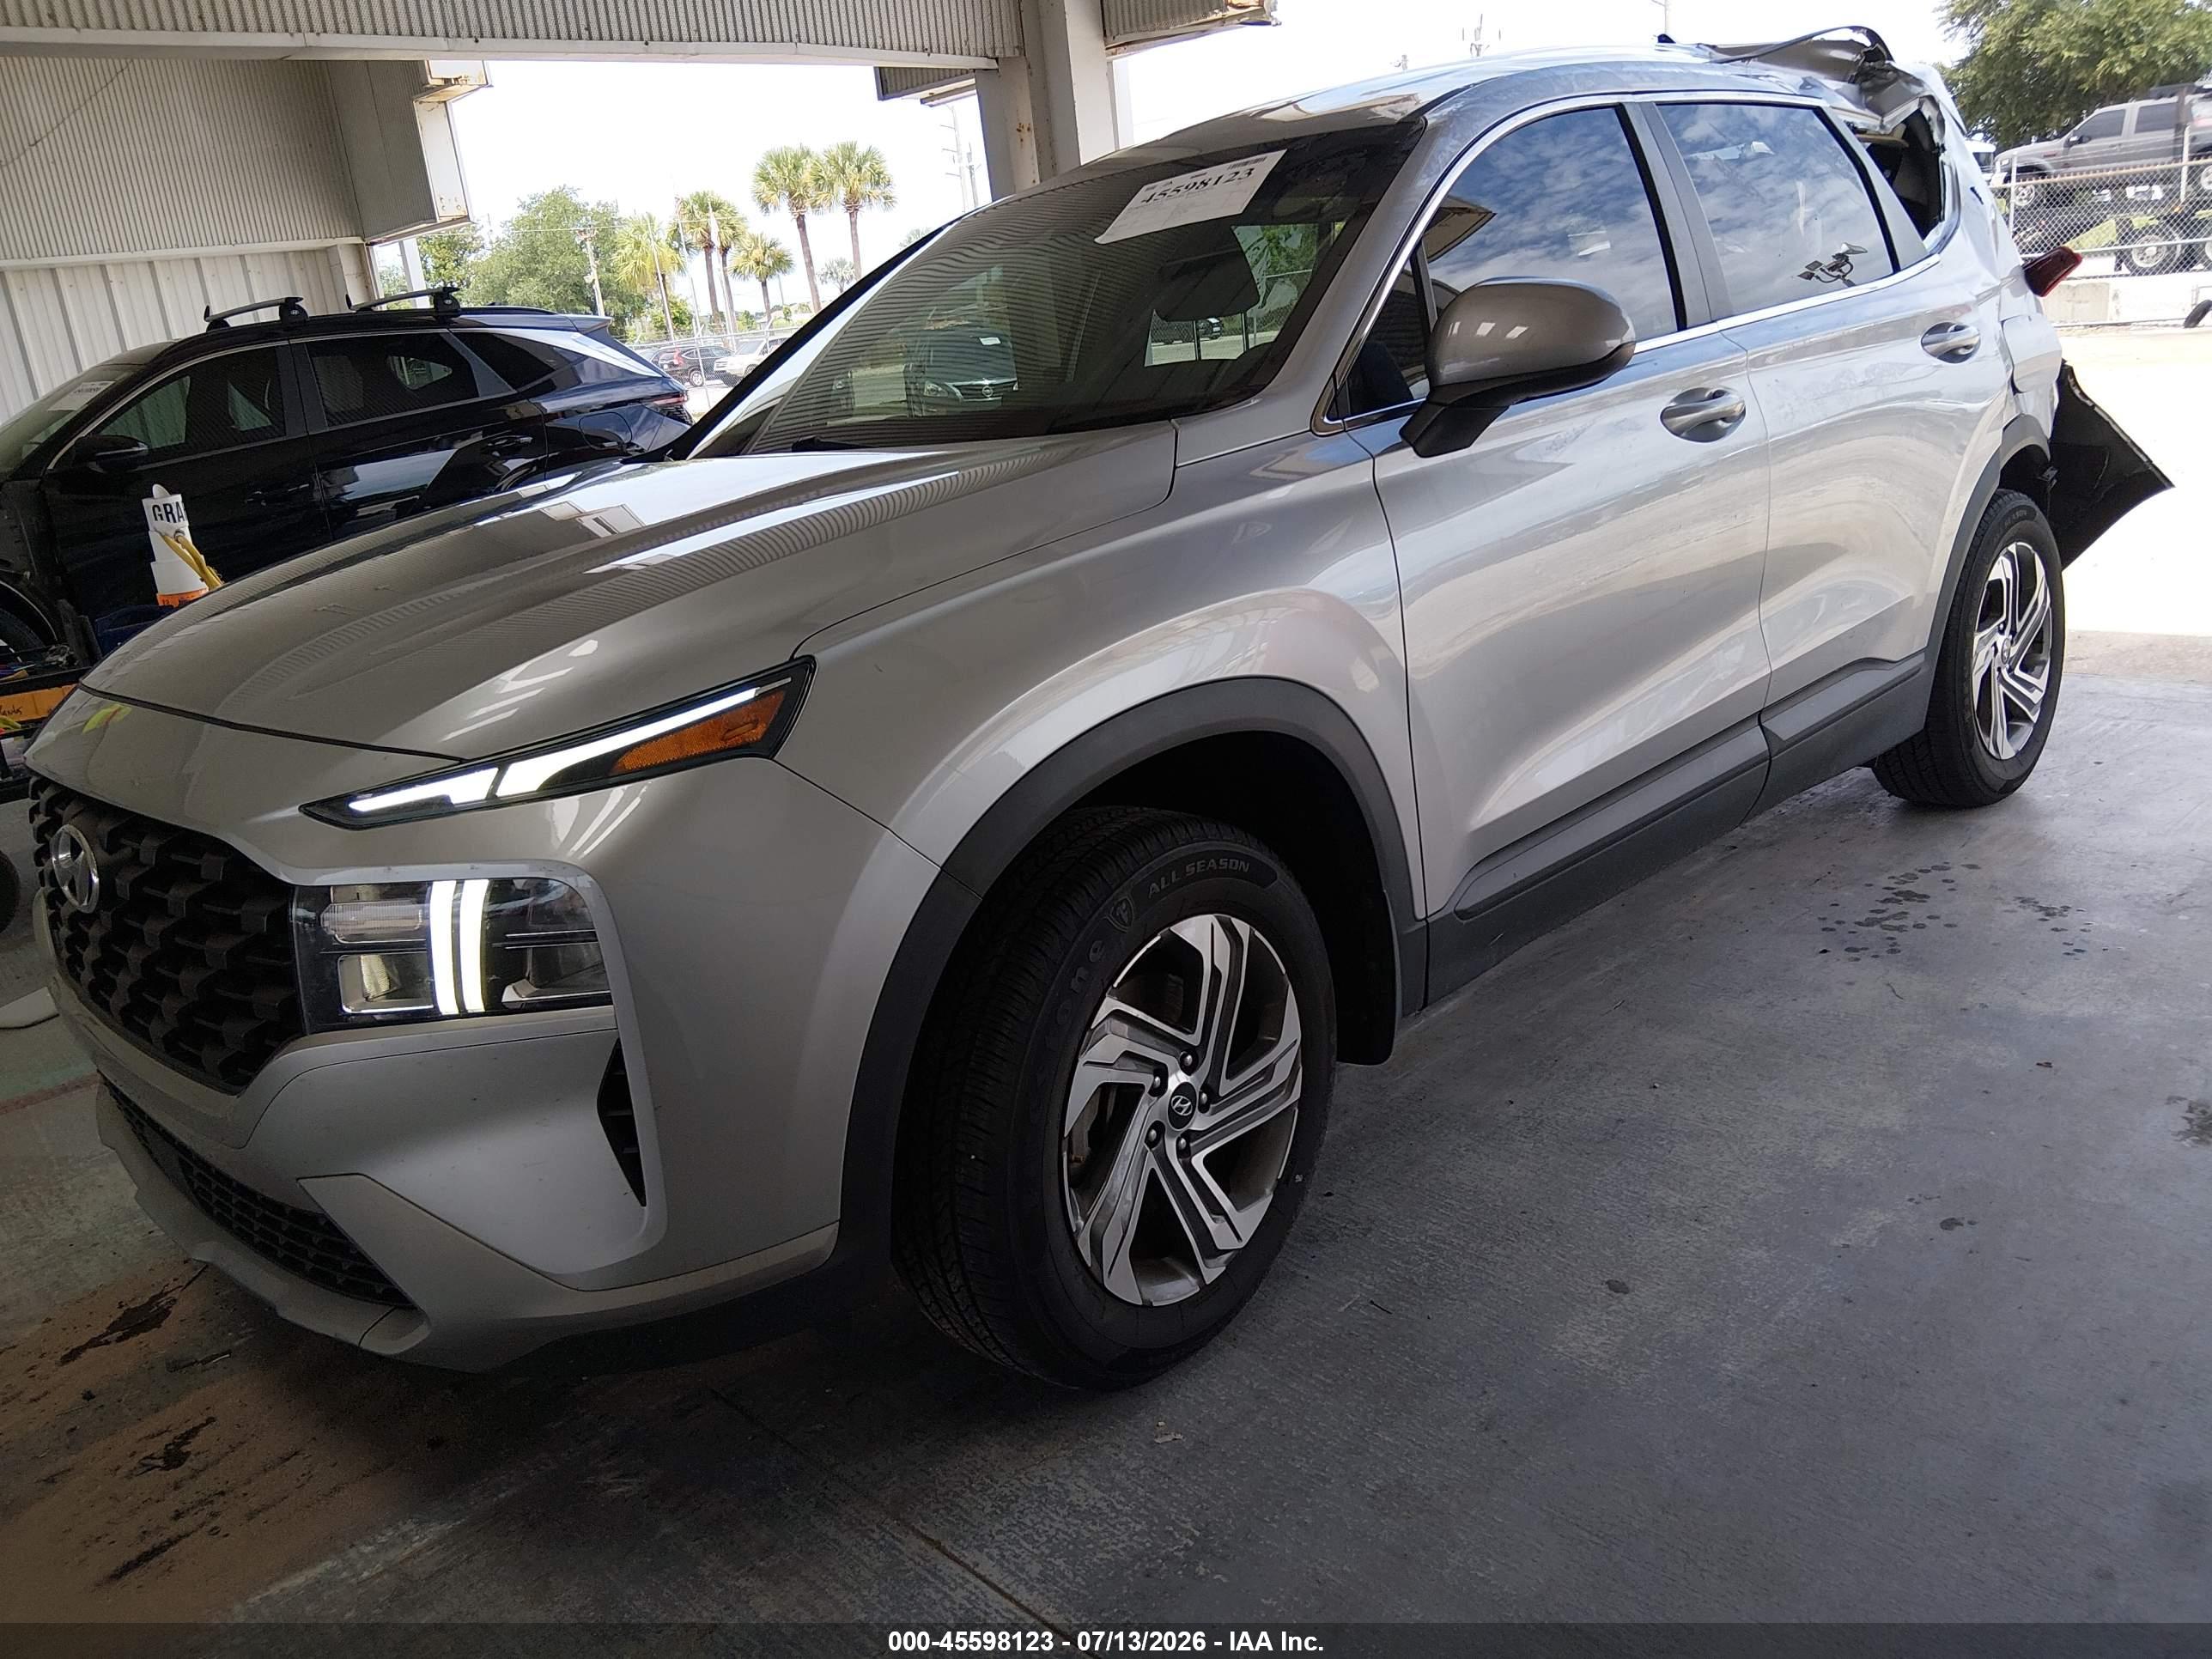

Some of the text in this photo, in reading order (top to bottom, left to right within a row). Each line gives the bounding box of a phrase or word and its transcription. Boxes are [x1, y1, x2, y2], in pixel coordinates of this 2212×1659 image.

[1140, 167, 1255, 204] 45598123
[1148, 859, 1249, 899] ALL SEASON
